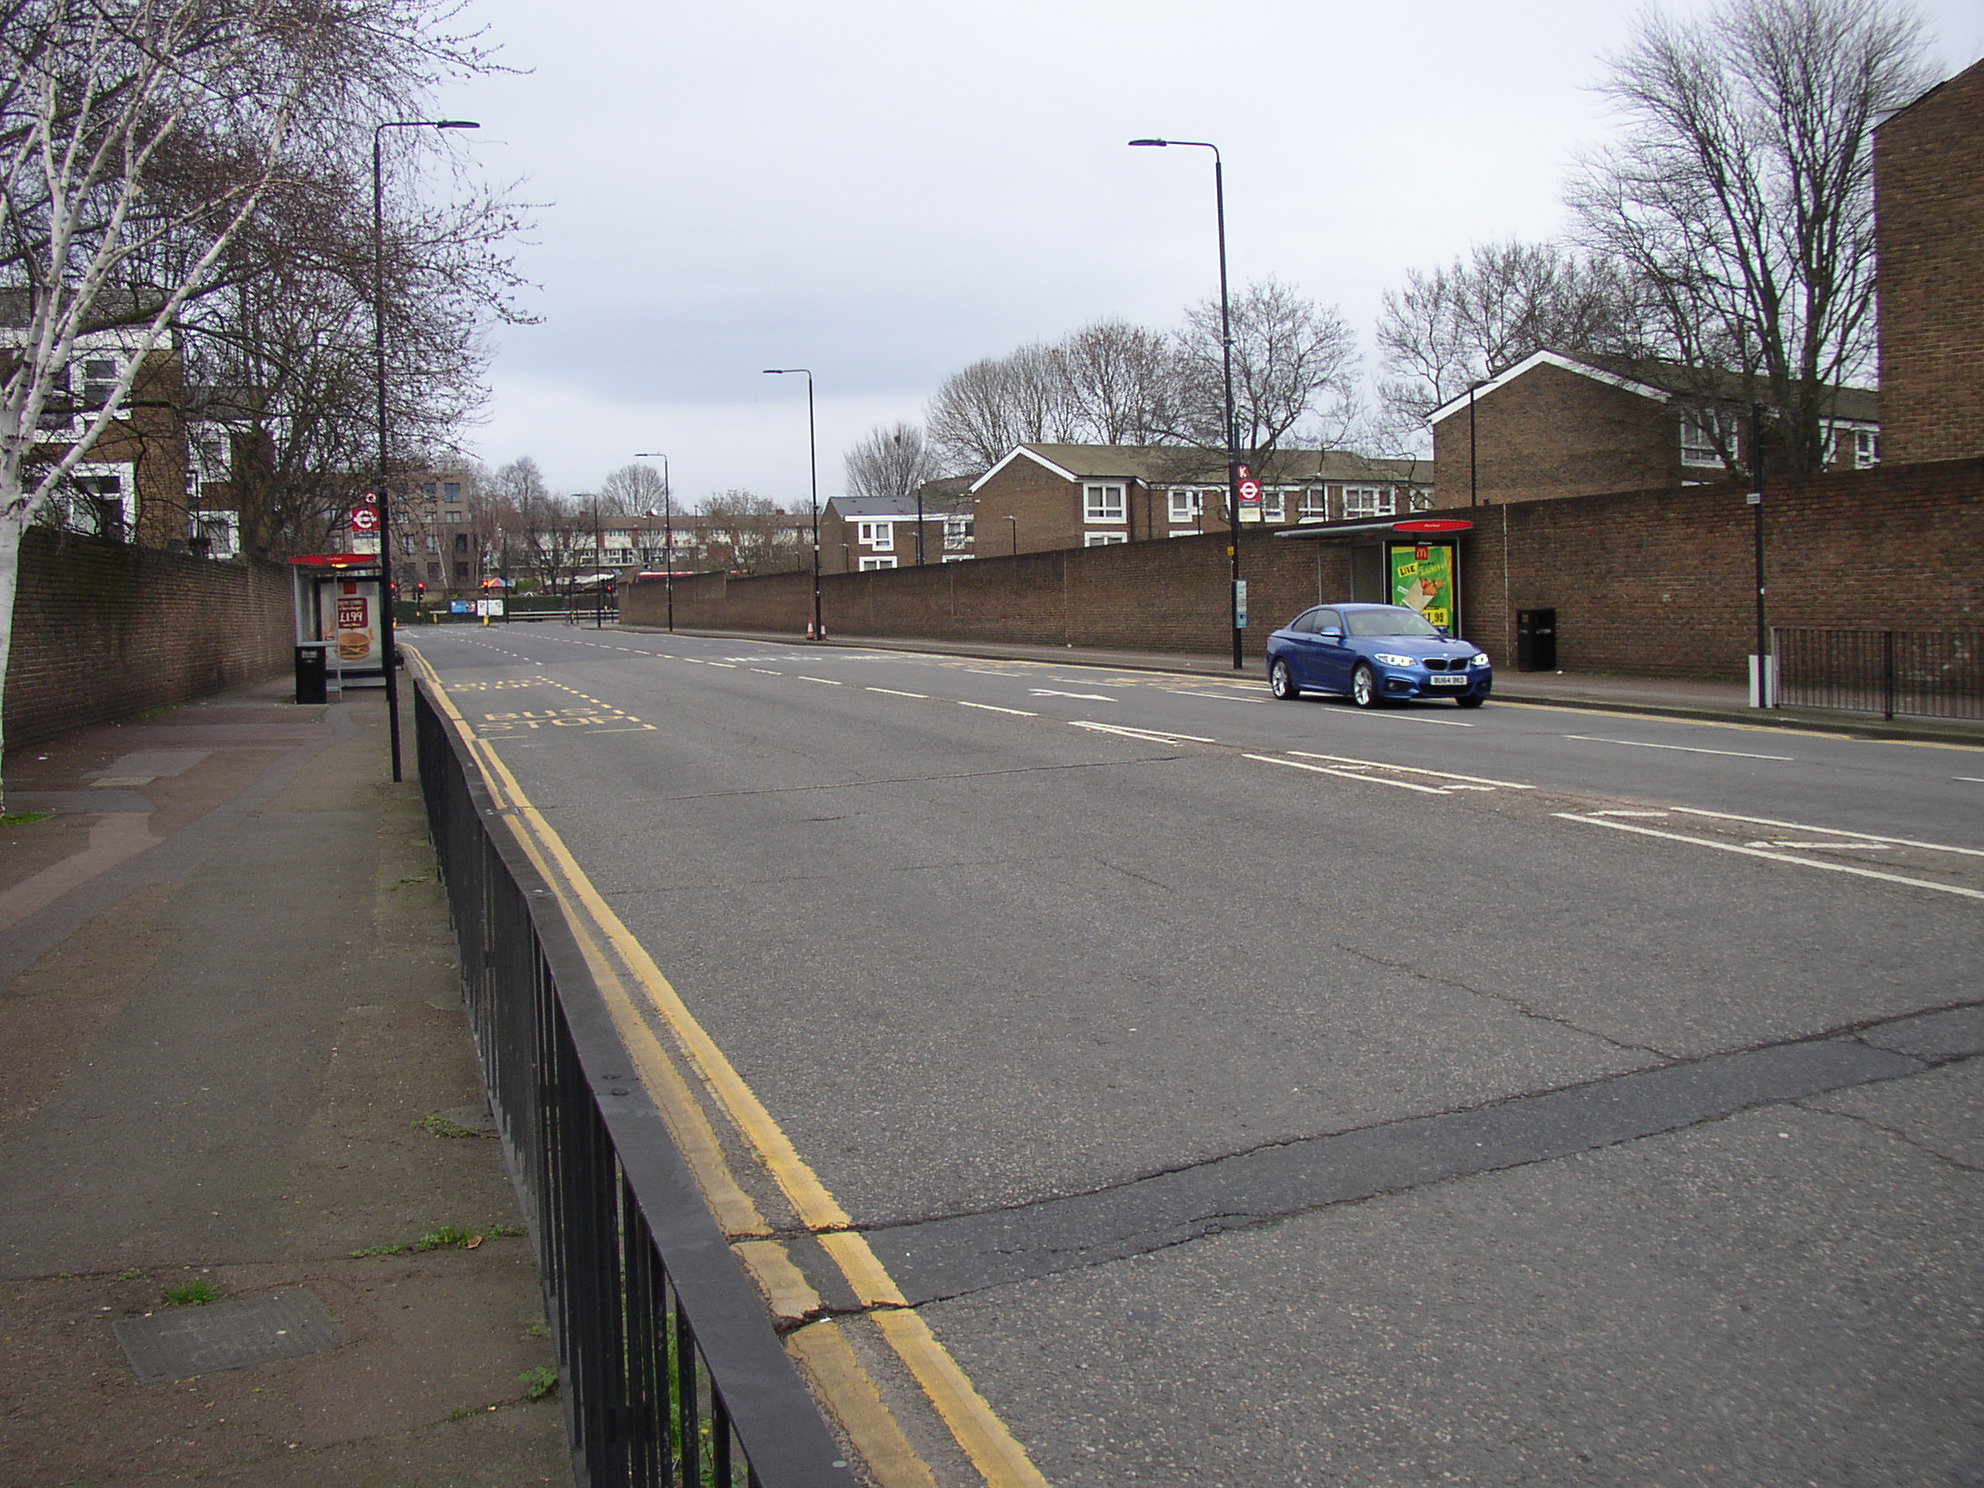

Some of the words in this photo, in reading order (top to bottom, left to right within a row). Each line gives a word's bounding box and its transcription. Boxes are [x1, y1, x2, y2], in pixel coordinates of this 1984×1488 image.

[1239, 466, 1248, 479] K
[365, 493, 377, 504] Q
[484, 706, 599, 721] BUS
[478, 715, 630, 731] STOP
